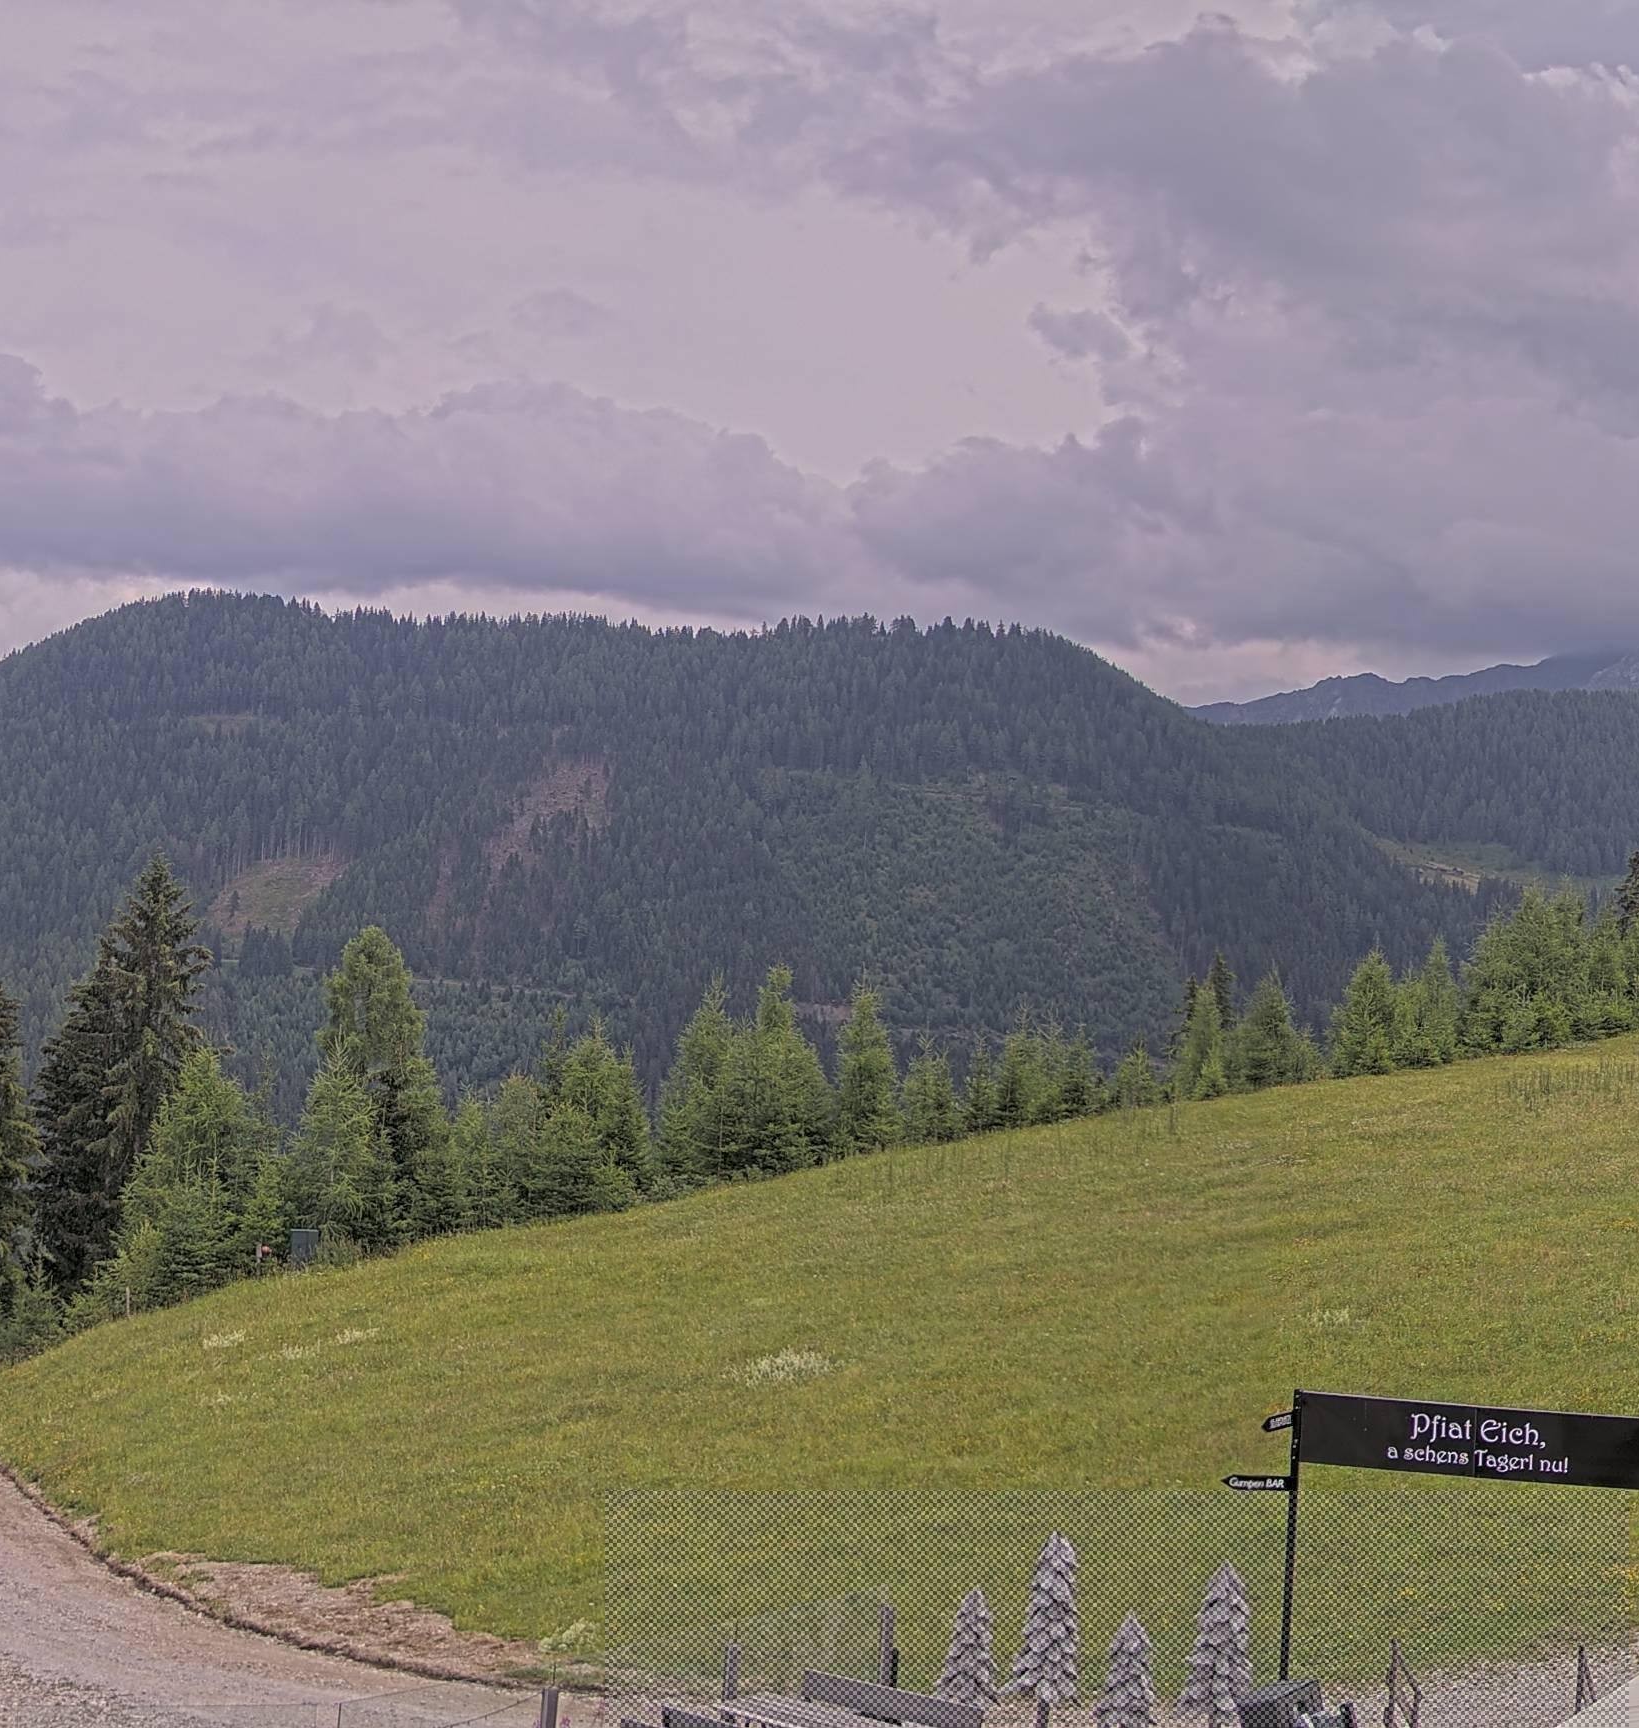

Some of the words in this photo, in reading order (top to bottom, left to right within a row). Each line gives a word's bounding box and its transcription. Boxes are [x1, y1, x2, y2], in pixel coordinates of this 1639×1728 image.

[1409, 1413, 1473, 1443] Pfiat
[1480, 1418, 1547, 1449] Eich,
[1387, 1446, 1399, 1459] a
[1403, 1445, 1470, 1465] schens
[1474, 1449, 1534, 1473] Tagerl
[1539, 1456, 1569, 1474] nu!
[1266, 1479, 1284, 1488] BAR
